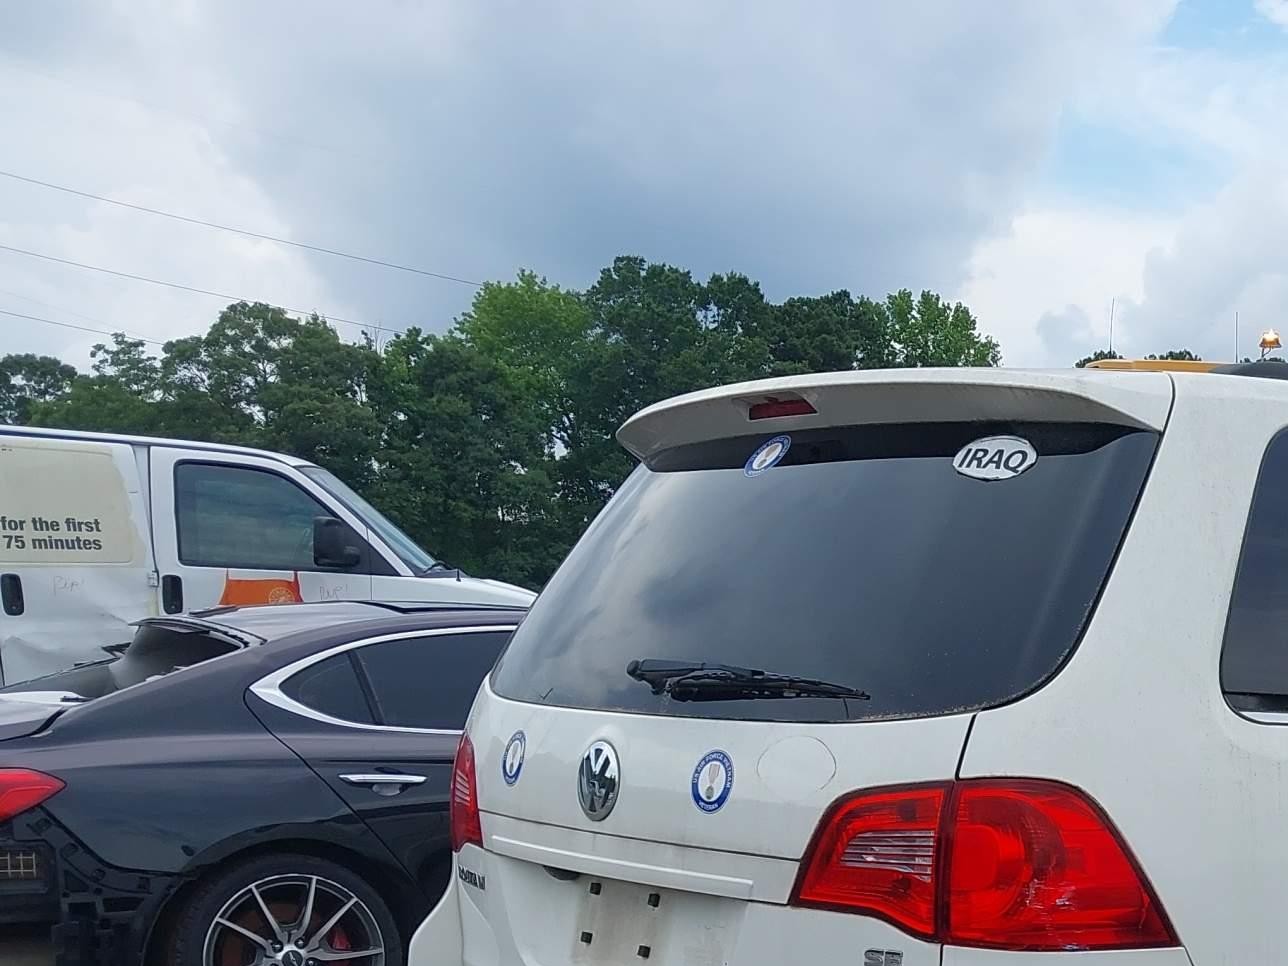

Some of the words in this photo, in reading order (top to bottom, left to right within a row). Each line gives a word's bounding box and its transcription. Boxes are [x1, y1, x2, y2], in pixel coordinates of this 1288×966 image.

[957, 448, 1029, 474] IRAQ
[0, 516, 26, 531] for
[31, 517, 60, 531] the
[65, 518, 102, 532] first
[2, 535, 26, 549] 75
[31, 536, 103, 550] minutes
